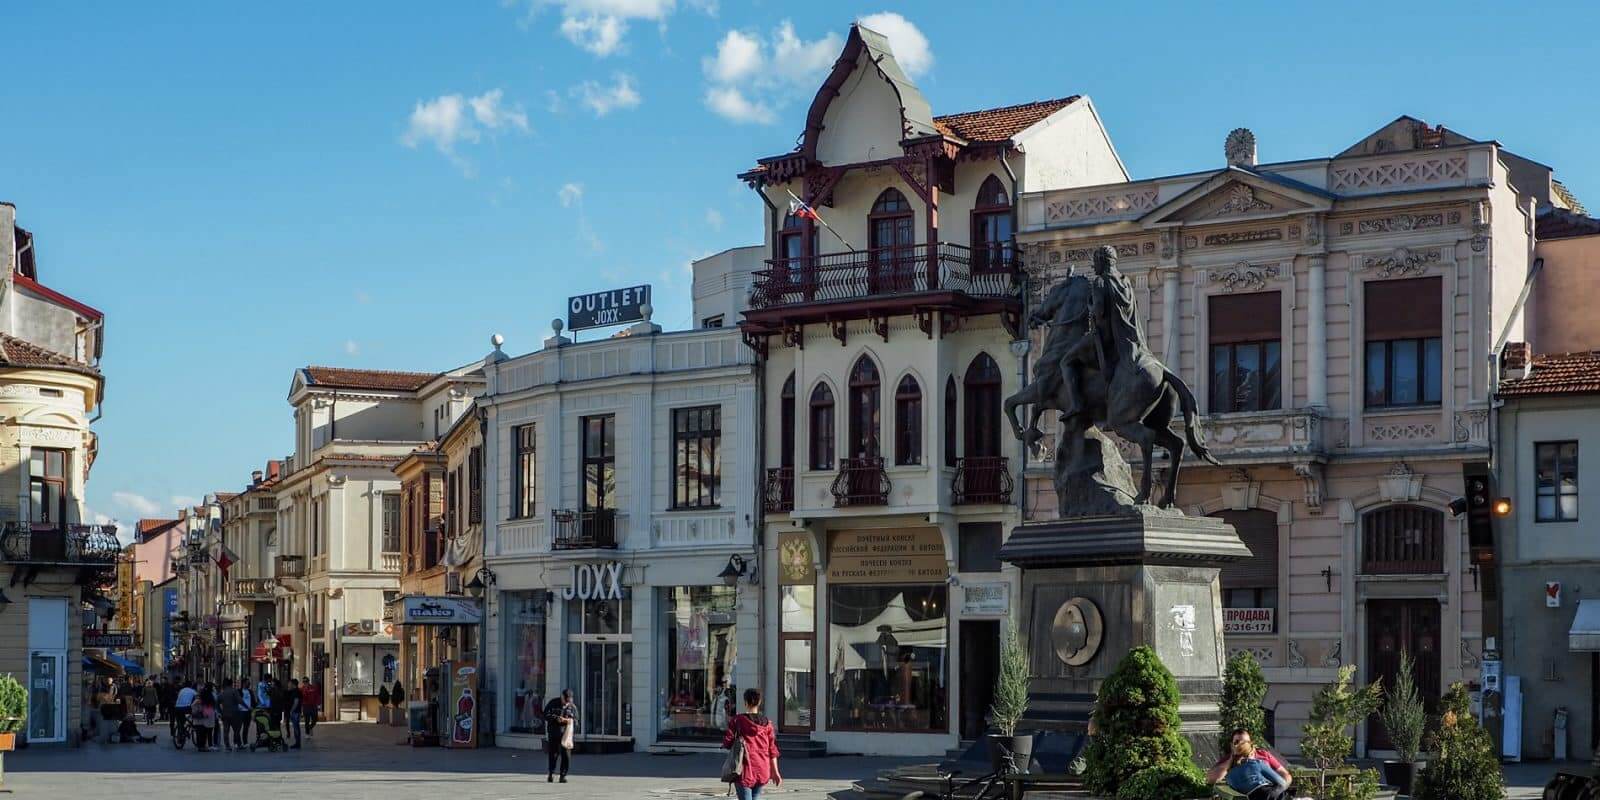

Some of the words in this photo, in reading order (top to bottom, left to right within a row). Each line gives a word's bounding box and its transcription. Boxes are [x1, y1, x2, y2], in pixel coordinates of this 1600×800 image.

[571, 287, 643, 314] OUTLET
[562, 562, 624, 600] JOXX
[1227, 610, 1270, 622] ПРОДАВА
